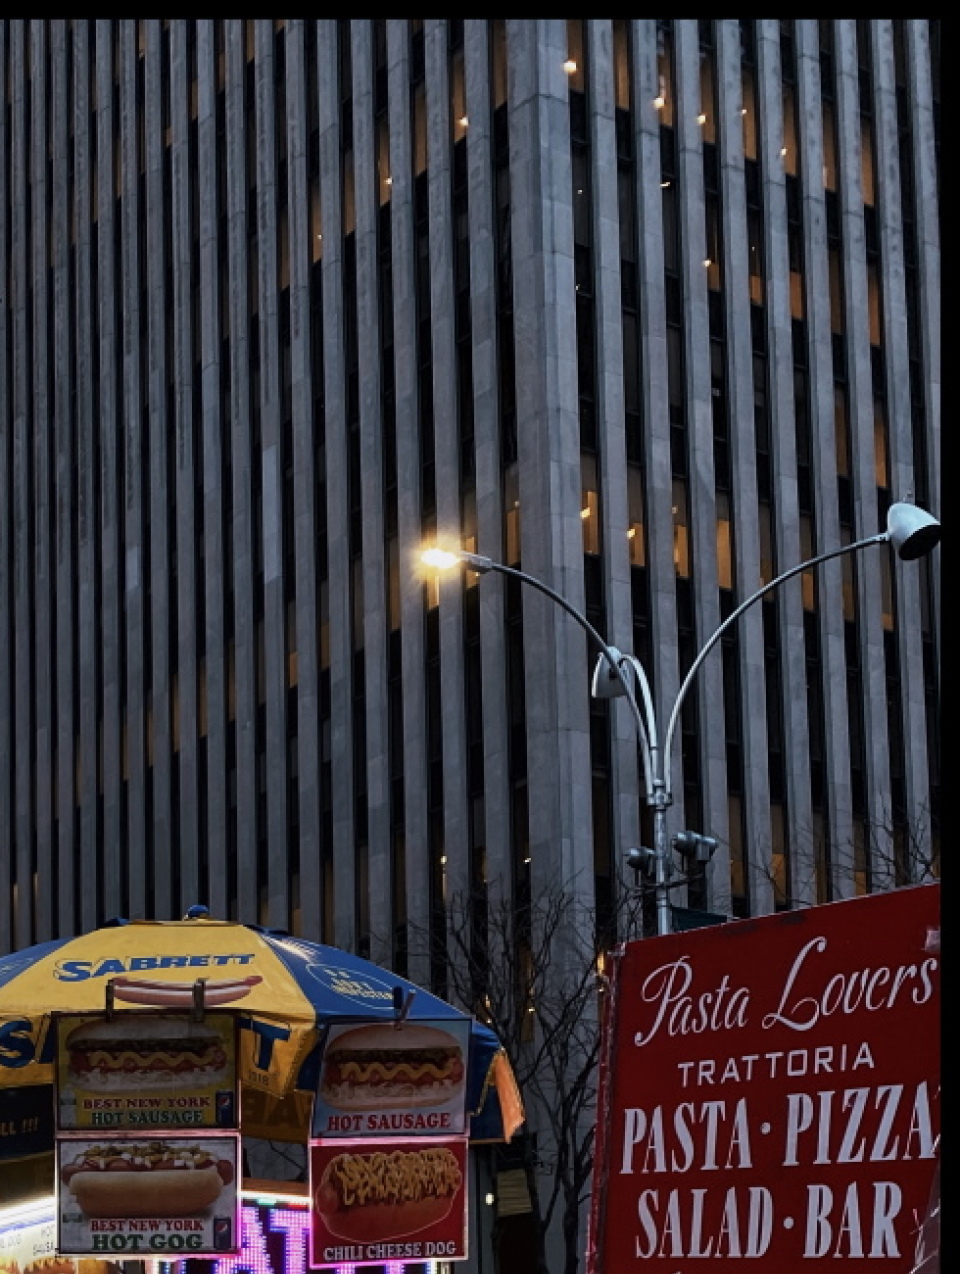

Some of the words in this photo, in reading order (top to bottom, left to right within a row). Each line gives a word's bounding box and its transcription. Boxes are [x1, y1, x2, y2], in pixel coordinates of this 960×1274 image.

[55, 953, 255, 983] SABRETT
[635, 955, 749, 1047] Pasta
[761, 936, 938, 1031] Lovers
[678, 1042, 876, 1088] TRATTORIA
[83, 1098, 123, 1110] BEST
[126, 1098, 163, 1110] NEW
[166, 1096, 211, 1108] YORK
[91, 1111, 123, 1126] HOT
[126, 1110, 203, 1125] SAUSAGE
[327, 1115, 363, 1131] HOT
[367, 1112, 451, 1130] SAUSAGE
[91, 1220, 124, 1231] BEST
[128, 1220, 163, 1231] NEW
[166, 1219, 205, 1231] YORK
[91, 1234, 144, 1250] HOT
[148, 1234, 204, 1249] GOG
[324, 1246, 364, 1261] CHILI
[365, 1243, 422, 1260] CHEESE
[423, 1241, 457, 1256] DOG
